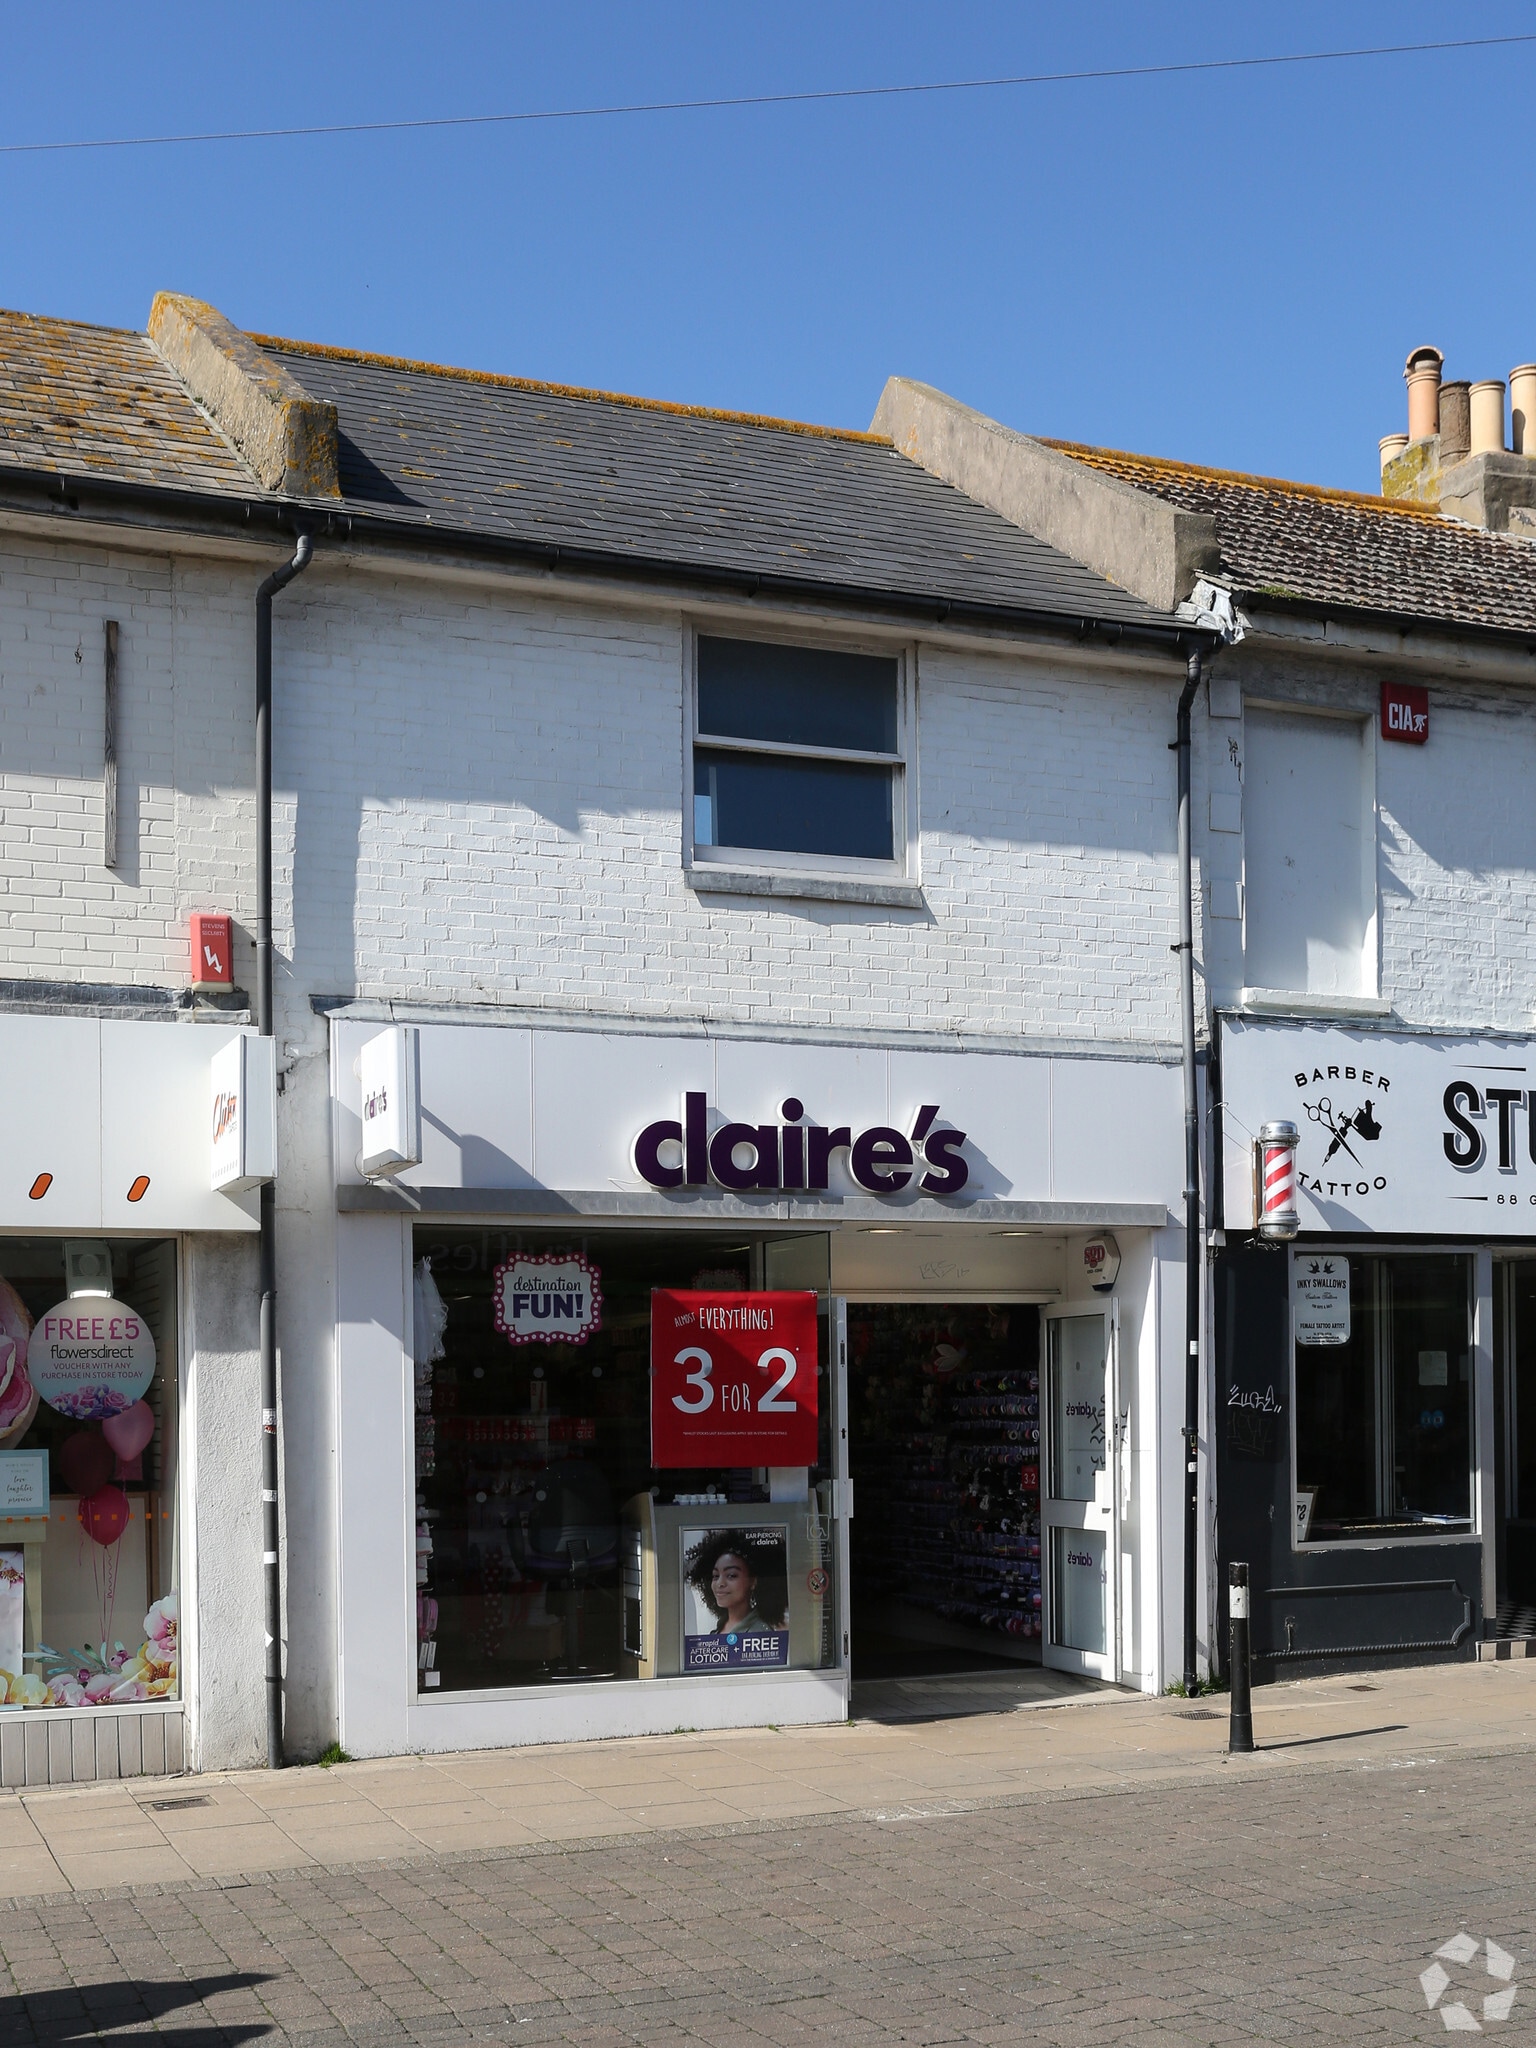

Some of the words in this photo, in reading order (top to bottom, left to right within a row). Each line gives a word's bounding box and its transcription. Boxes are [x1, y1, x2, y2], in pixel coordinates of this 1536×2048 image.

[1389, 702, 1413, 731] CIA
[1294, 1066, 1391, 1093] BARBER
[1443, 1080, 1536, 1175] ST
[632, 1090, 969, 1194] claire's
[1298, 1171, 1387, 1197] TATTOO
[1496, 1194, 1518, 1206] 88
[513, 1276, 582, 1292] destination
[1296, 1279, 1312, 1289] INKY
[1312, 1278, 1347, 1289] SWALLOWS
[512, 1293, 584, 1319] FUN!
[674, 1311, 696, 1327] ALMOST
[699, 1307, 775, 1330] EVERYTHING!
[44, 1317, 105, 1340] FREE
[108, 1317, 140, 1340] £5
[50, 1344, 134, 1359] flowersdirect
[41, 1371, 81, 1379] PURCHASE
[82, 1371, 91, 1379] IN
[92, 1371, 116, 1379] STORE
[117, 1371, 143, 1379] TODAY
[53, 1362, 91, 1370] VOUCHER
[91, 1362, 113, 1370] WITH
[671, 1346, 715, 1414] 3
[721, 1383, 751, 1412] FOR
[756, 1538, 779, 1546] claire's
[690, 1647, 711, 1655] AFTER
[711, 1646, 729, 1654] CARE
[742, 1637, 780, 1652] FREE
[701, 1638, 720, 1648] rapid
[690, 1653, 729, 1664] LOTION
